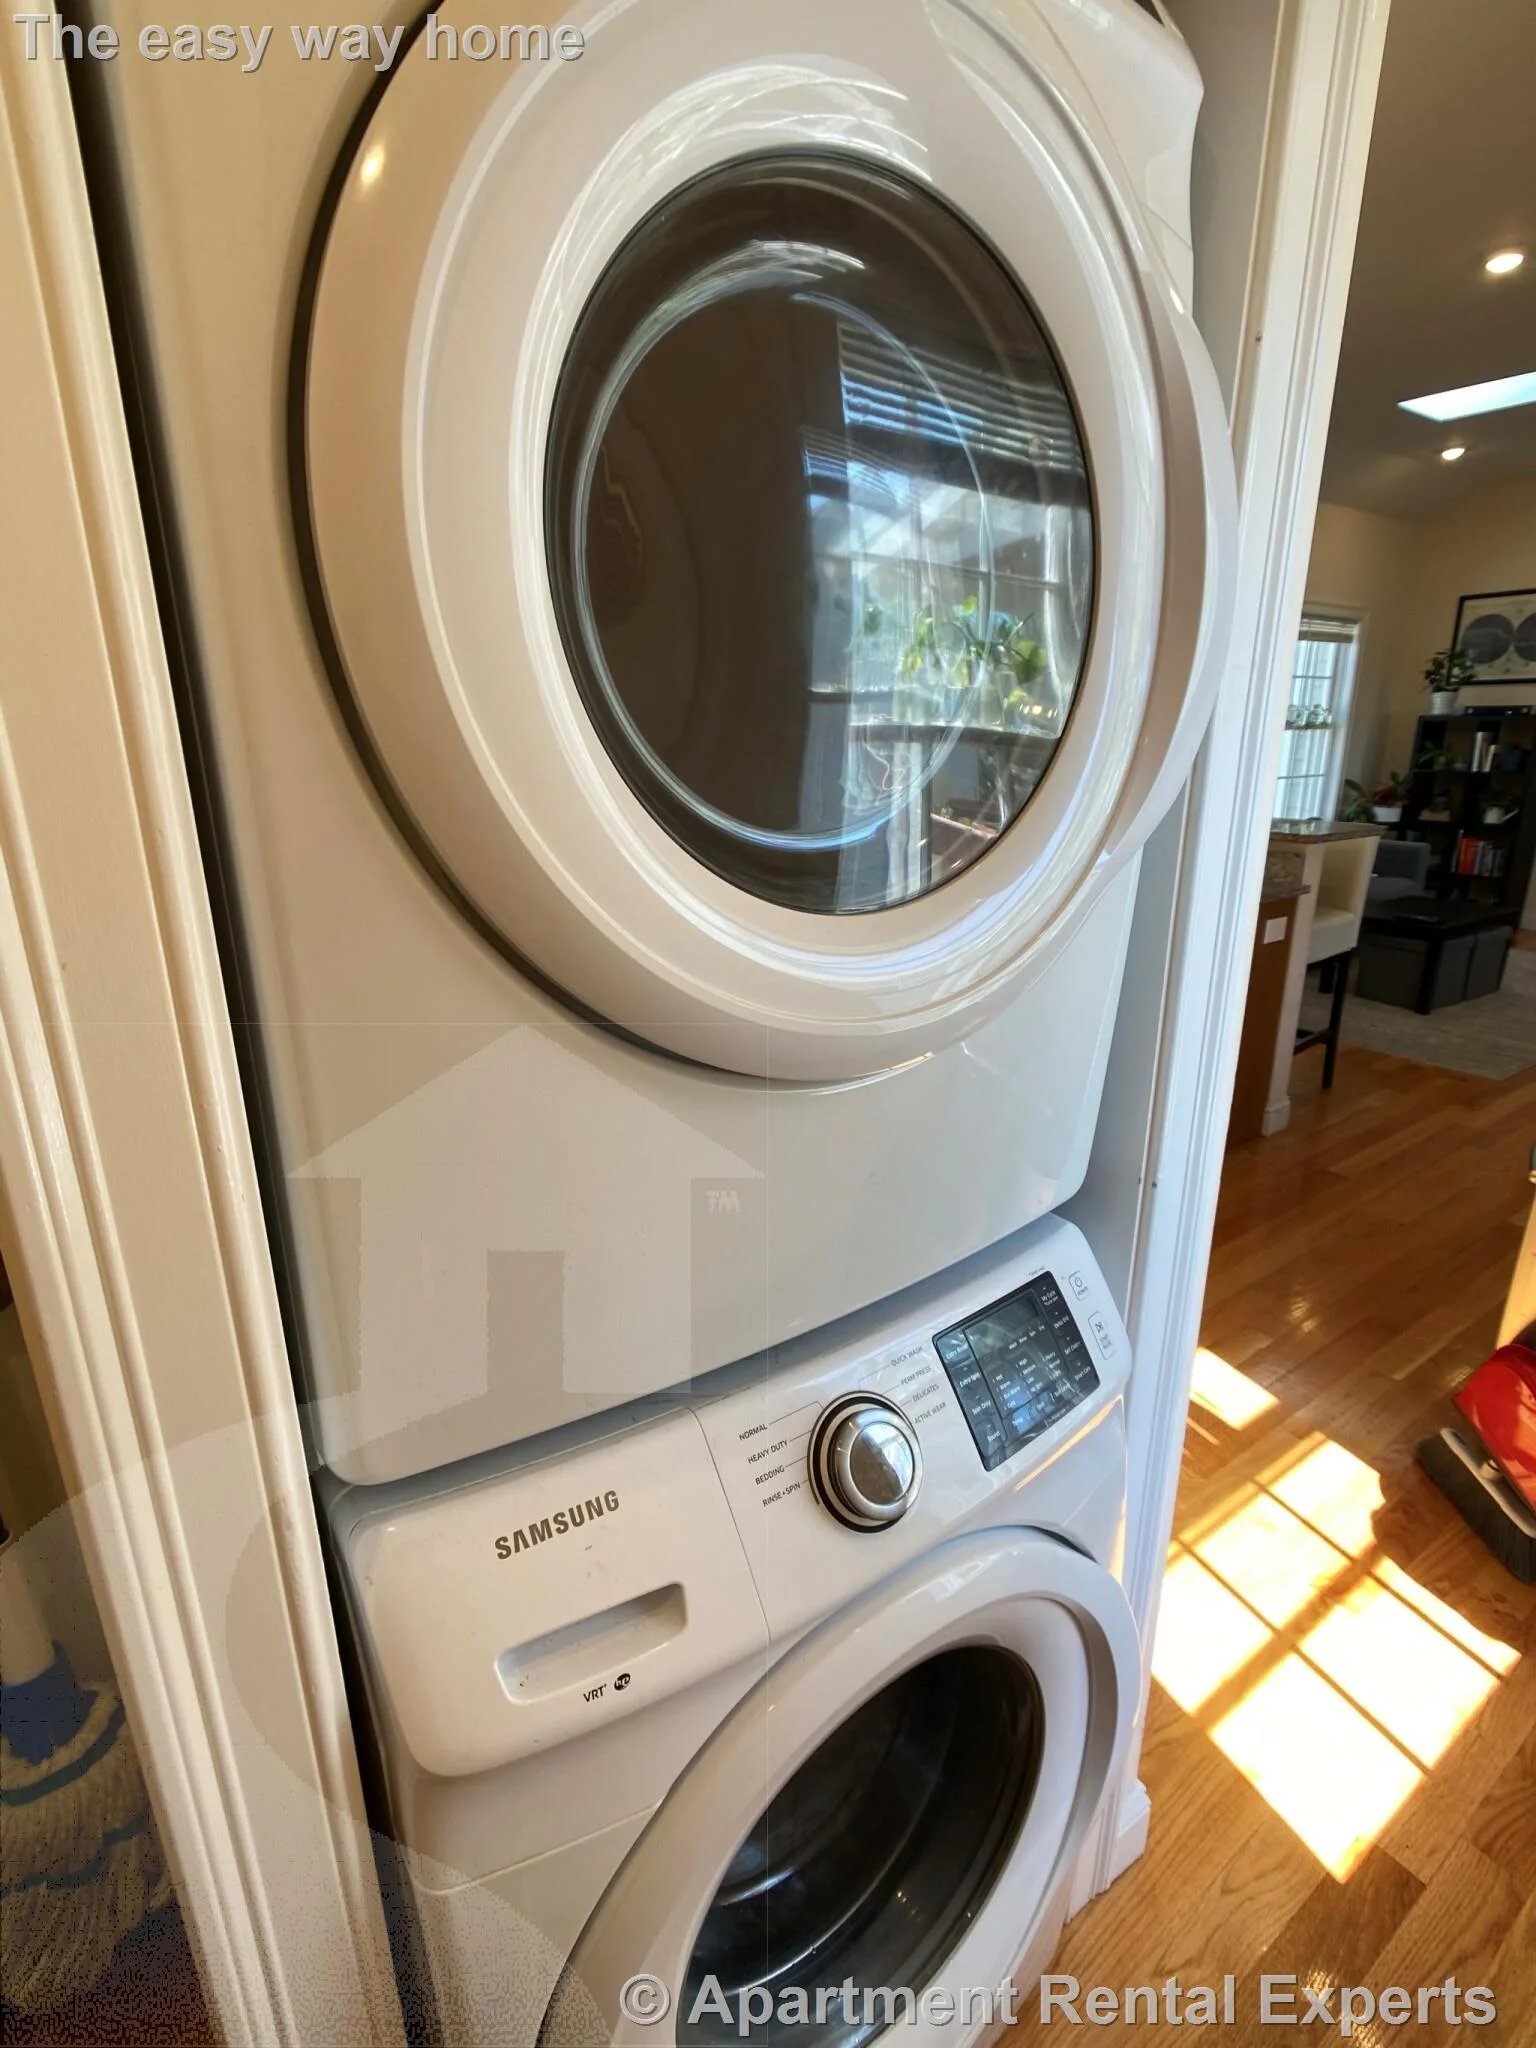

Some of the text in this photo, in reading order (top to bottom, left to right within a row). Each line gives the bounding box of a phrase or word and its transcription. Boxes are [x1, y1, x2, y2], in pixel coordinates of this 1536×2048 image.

[912, 1383, 940, 1402] DELICATES
[914, 1411, 932, 1424] ACTIVE
[738, 1423, 768, 1441] NORMAL
[747, 1439, 788, 1464] HEAVY DUTY
[755, 1465, 785, 1485] BEDDING
[494, 1490, 620, 1560] SAMSUNG
